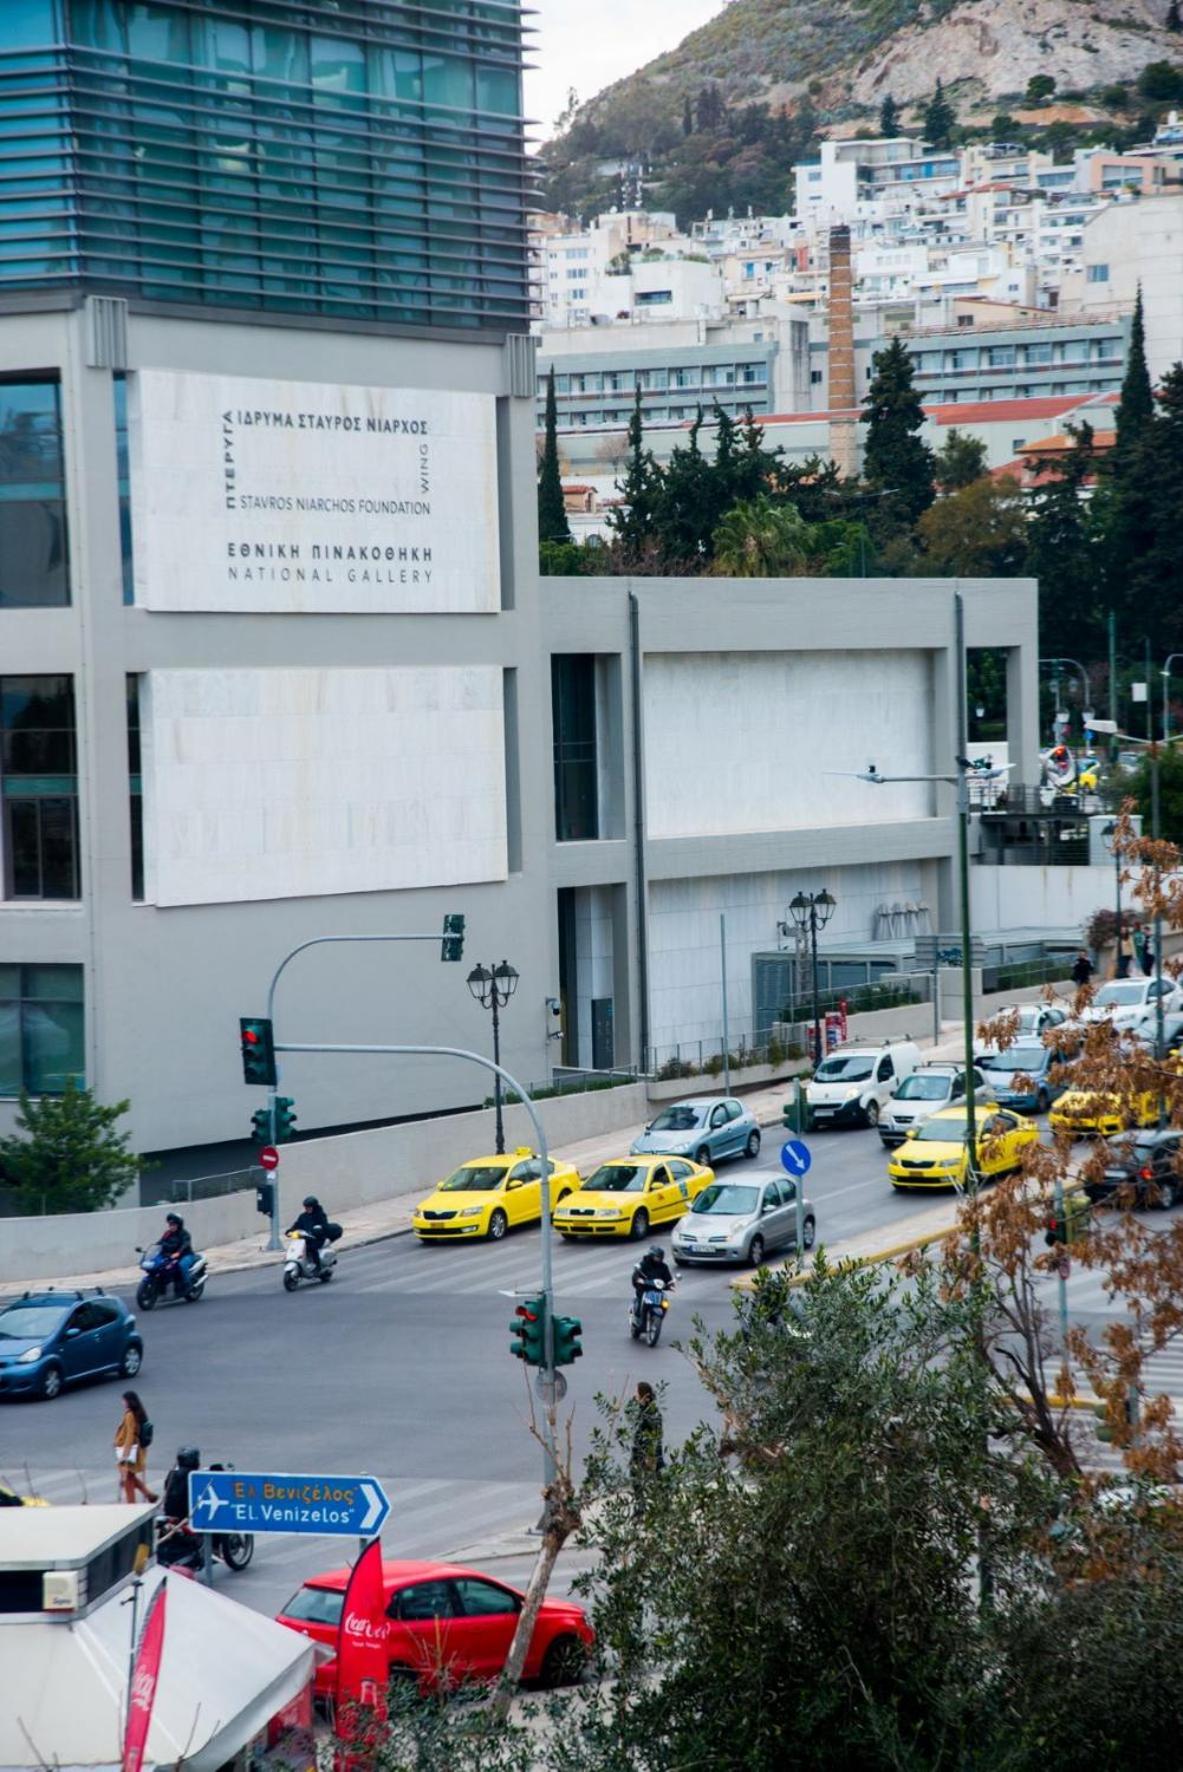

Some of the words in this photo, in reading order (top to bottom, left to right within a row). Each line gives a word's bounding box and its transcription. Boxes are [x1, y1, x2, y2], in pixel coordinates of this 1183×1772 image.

[237, 410, 294, 428] ΙΔΡΥΜΑ
[298, 413, 362, 432] ΣΤΑΥΡΟΣ
[366, 418, 429, 435] ΝΙΑΡΧΟΣ
[418, 443, 431, 494] WING
[239, 495, 293, 511] STAVROS
[296, 498, 355, 514] NIARCHOS
[358, 500, 431, 516] FOUNDATION
[228, 543, 300, 559] ΕΘΝΙΚΗ
[312, 545, 432, 562] ΠΙΝΑΚΟΘΗΚΗ
[228, 567, 333, 582] NATIONAL
[347, 568, 432, 584] GALLERY
